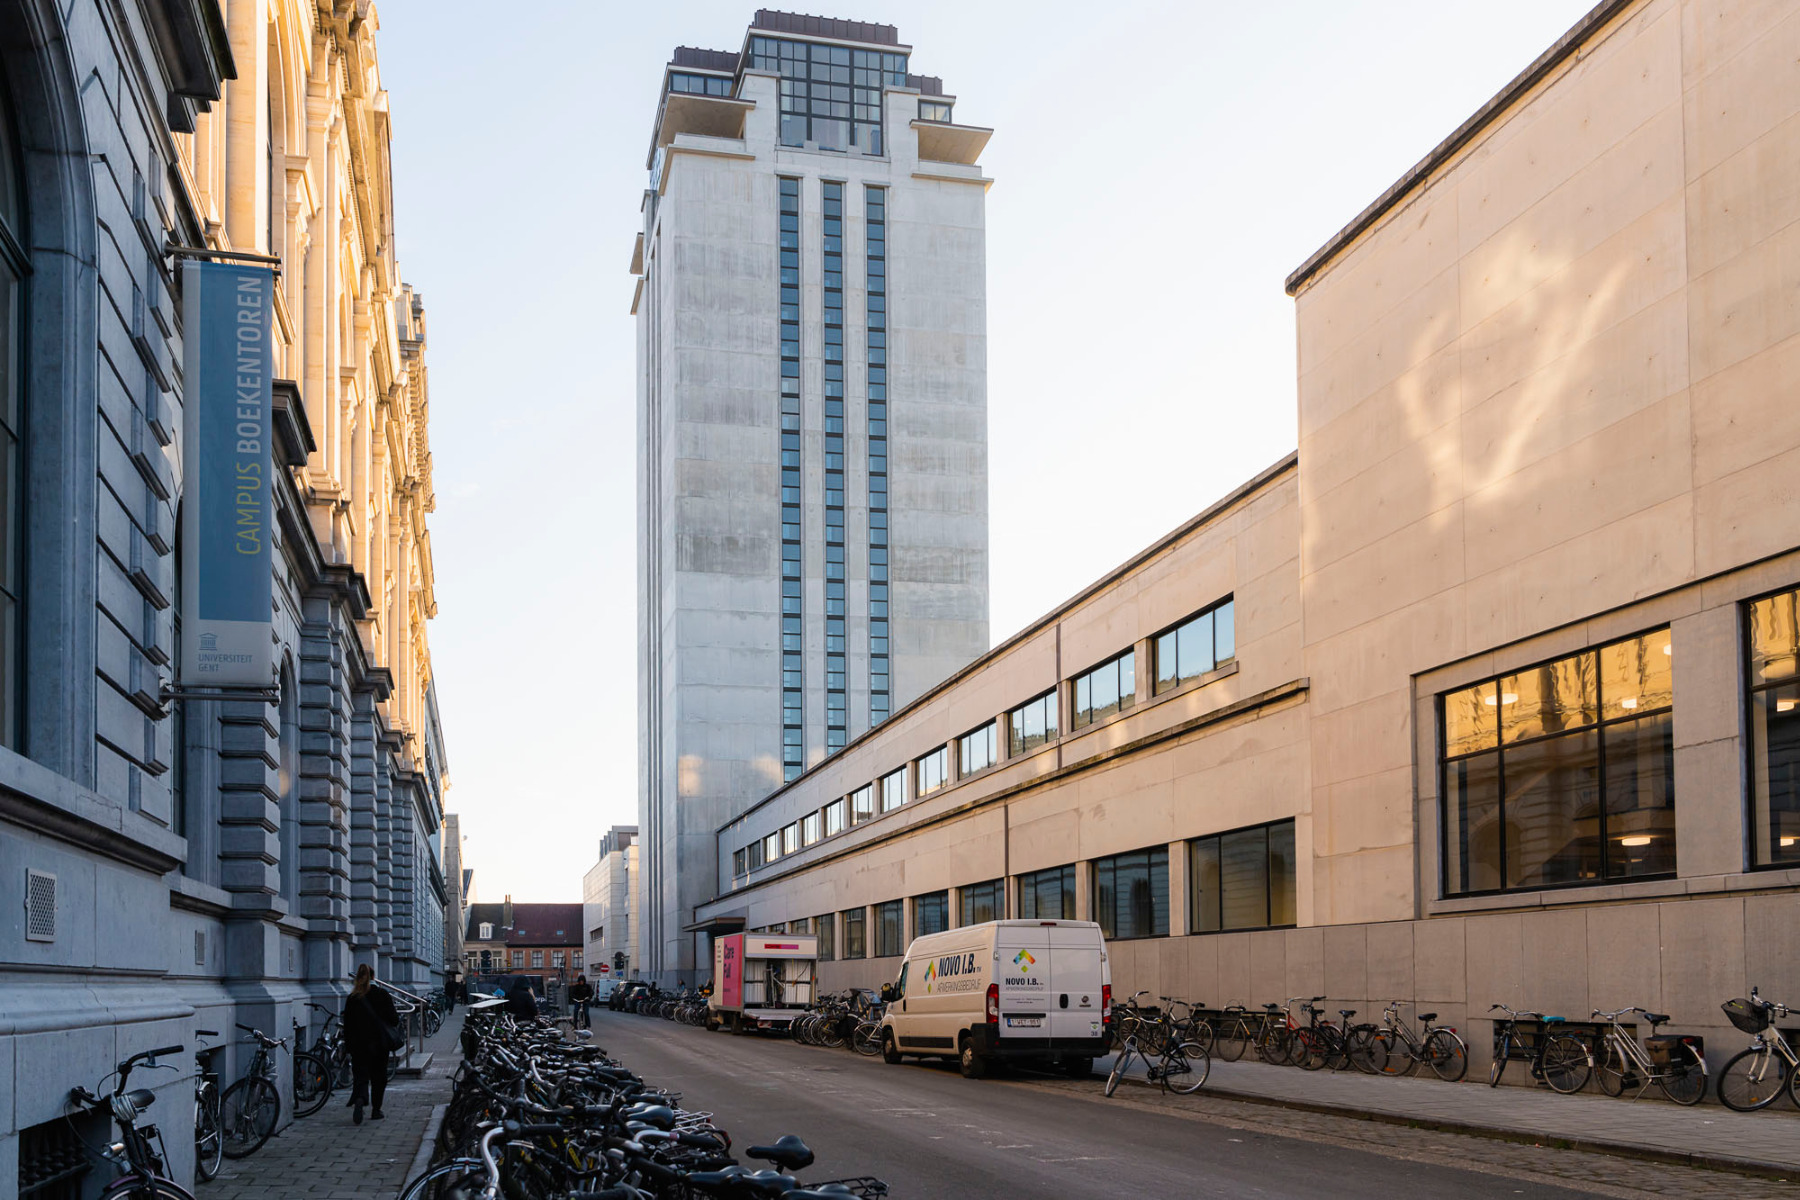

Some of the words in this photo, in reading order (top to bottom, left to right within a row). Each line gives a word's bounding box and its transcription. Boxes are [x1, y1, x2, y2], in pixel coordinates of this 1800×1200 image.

[236, 276, 262, 453] BOEKENTOREN
[236, 461, 261, 555] CAMPUS
[198, 653, 253, 664] UNIVERSITEIT
[198, 663, 219, 673] GENT
[938, 954, 961, 977] NOVO
[961, 952, 976, 975] I.B.
[1005, 977, 1026, 986] NOVO
[1027, 977, 1039, 986] I.B.
